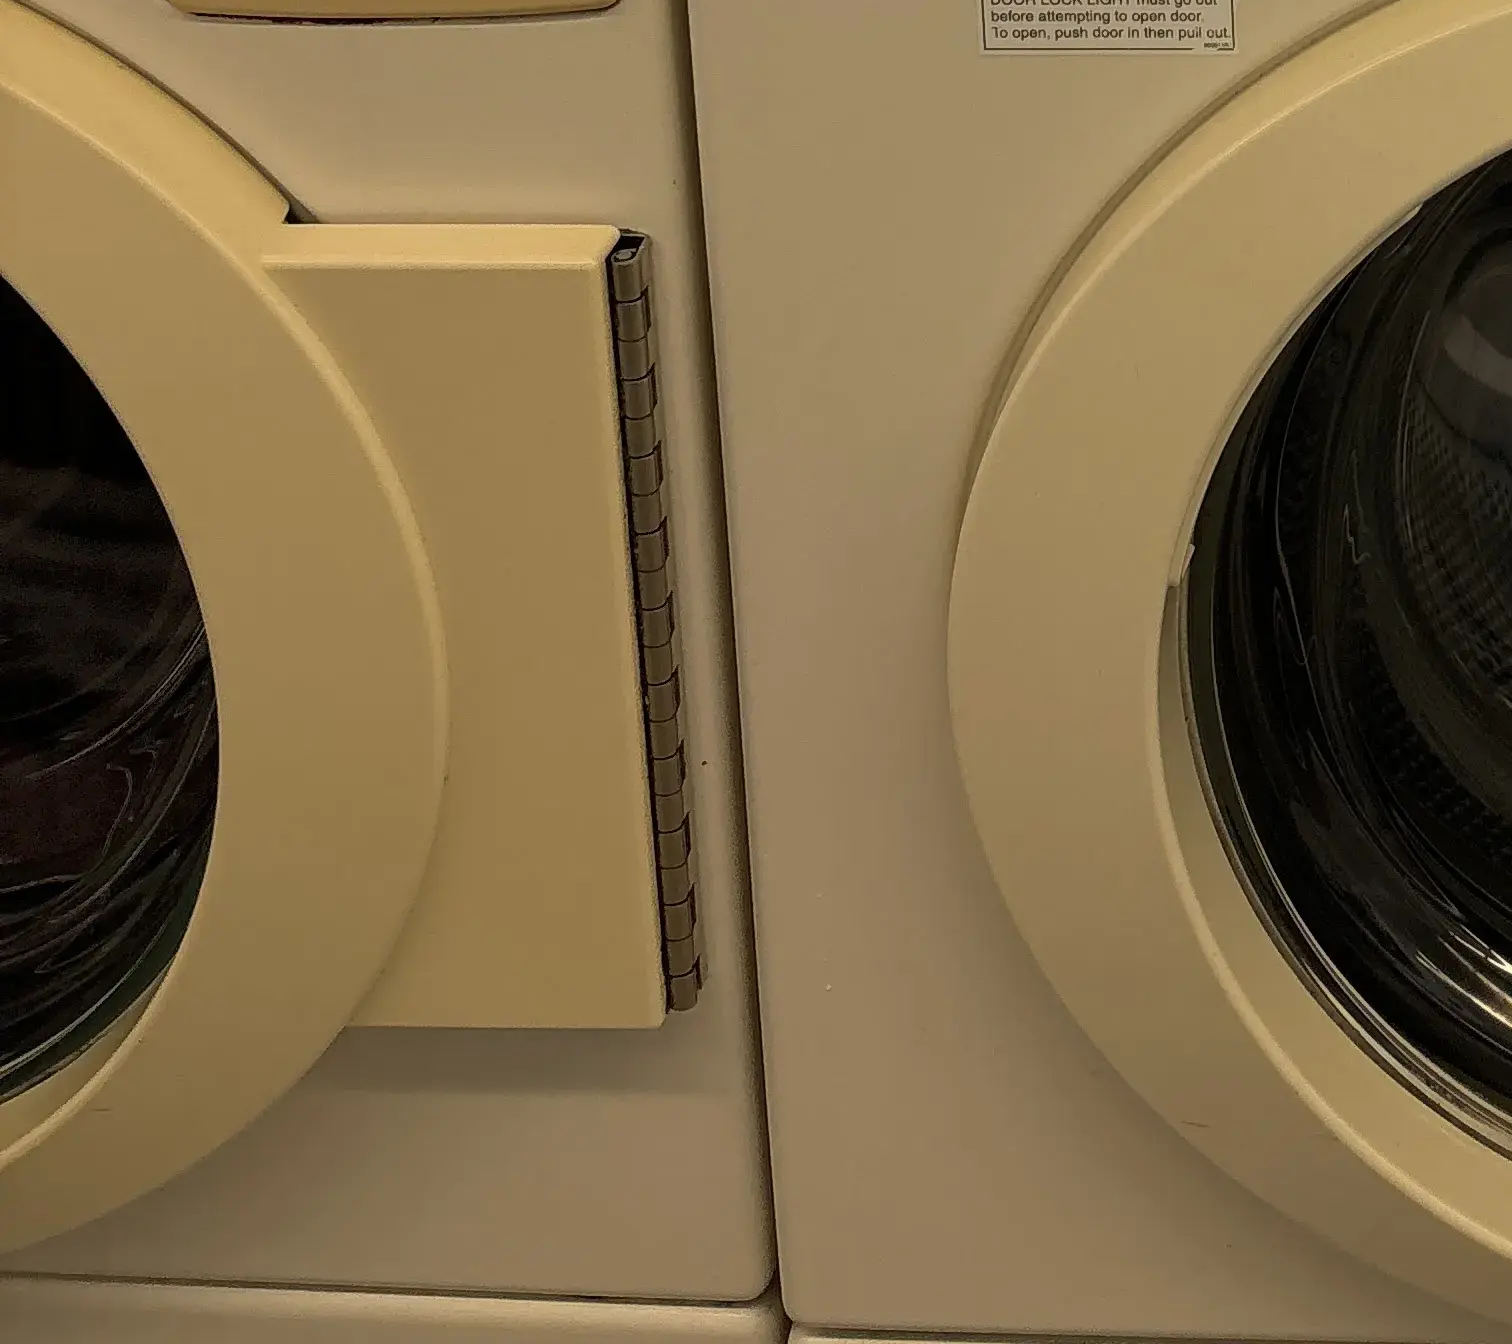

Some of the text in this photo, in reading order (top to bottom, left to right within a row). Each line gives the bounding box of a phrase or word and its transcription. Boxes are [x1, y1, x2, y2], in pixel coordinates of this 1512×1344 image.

[991, 10, 1205, 24] before attempting to open door.
[992, 27, 1230, 41] To open, push door in then pull out.
